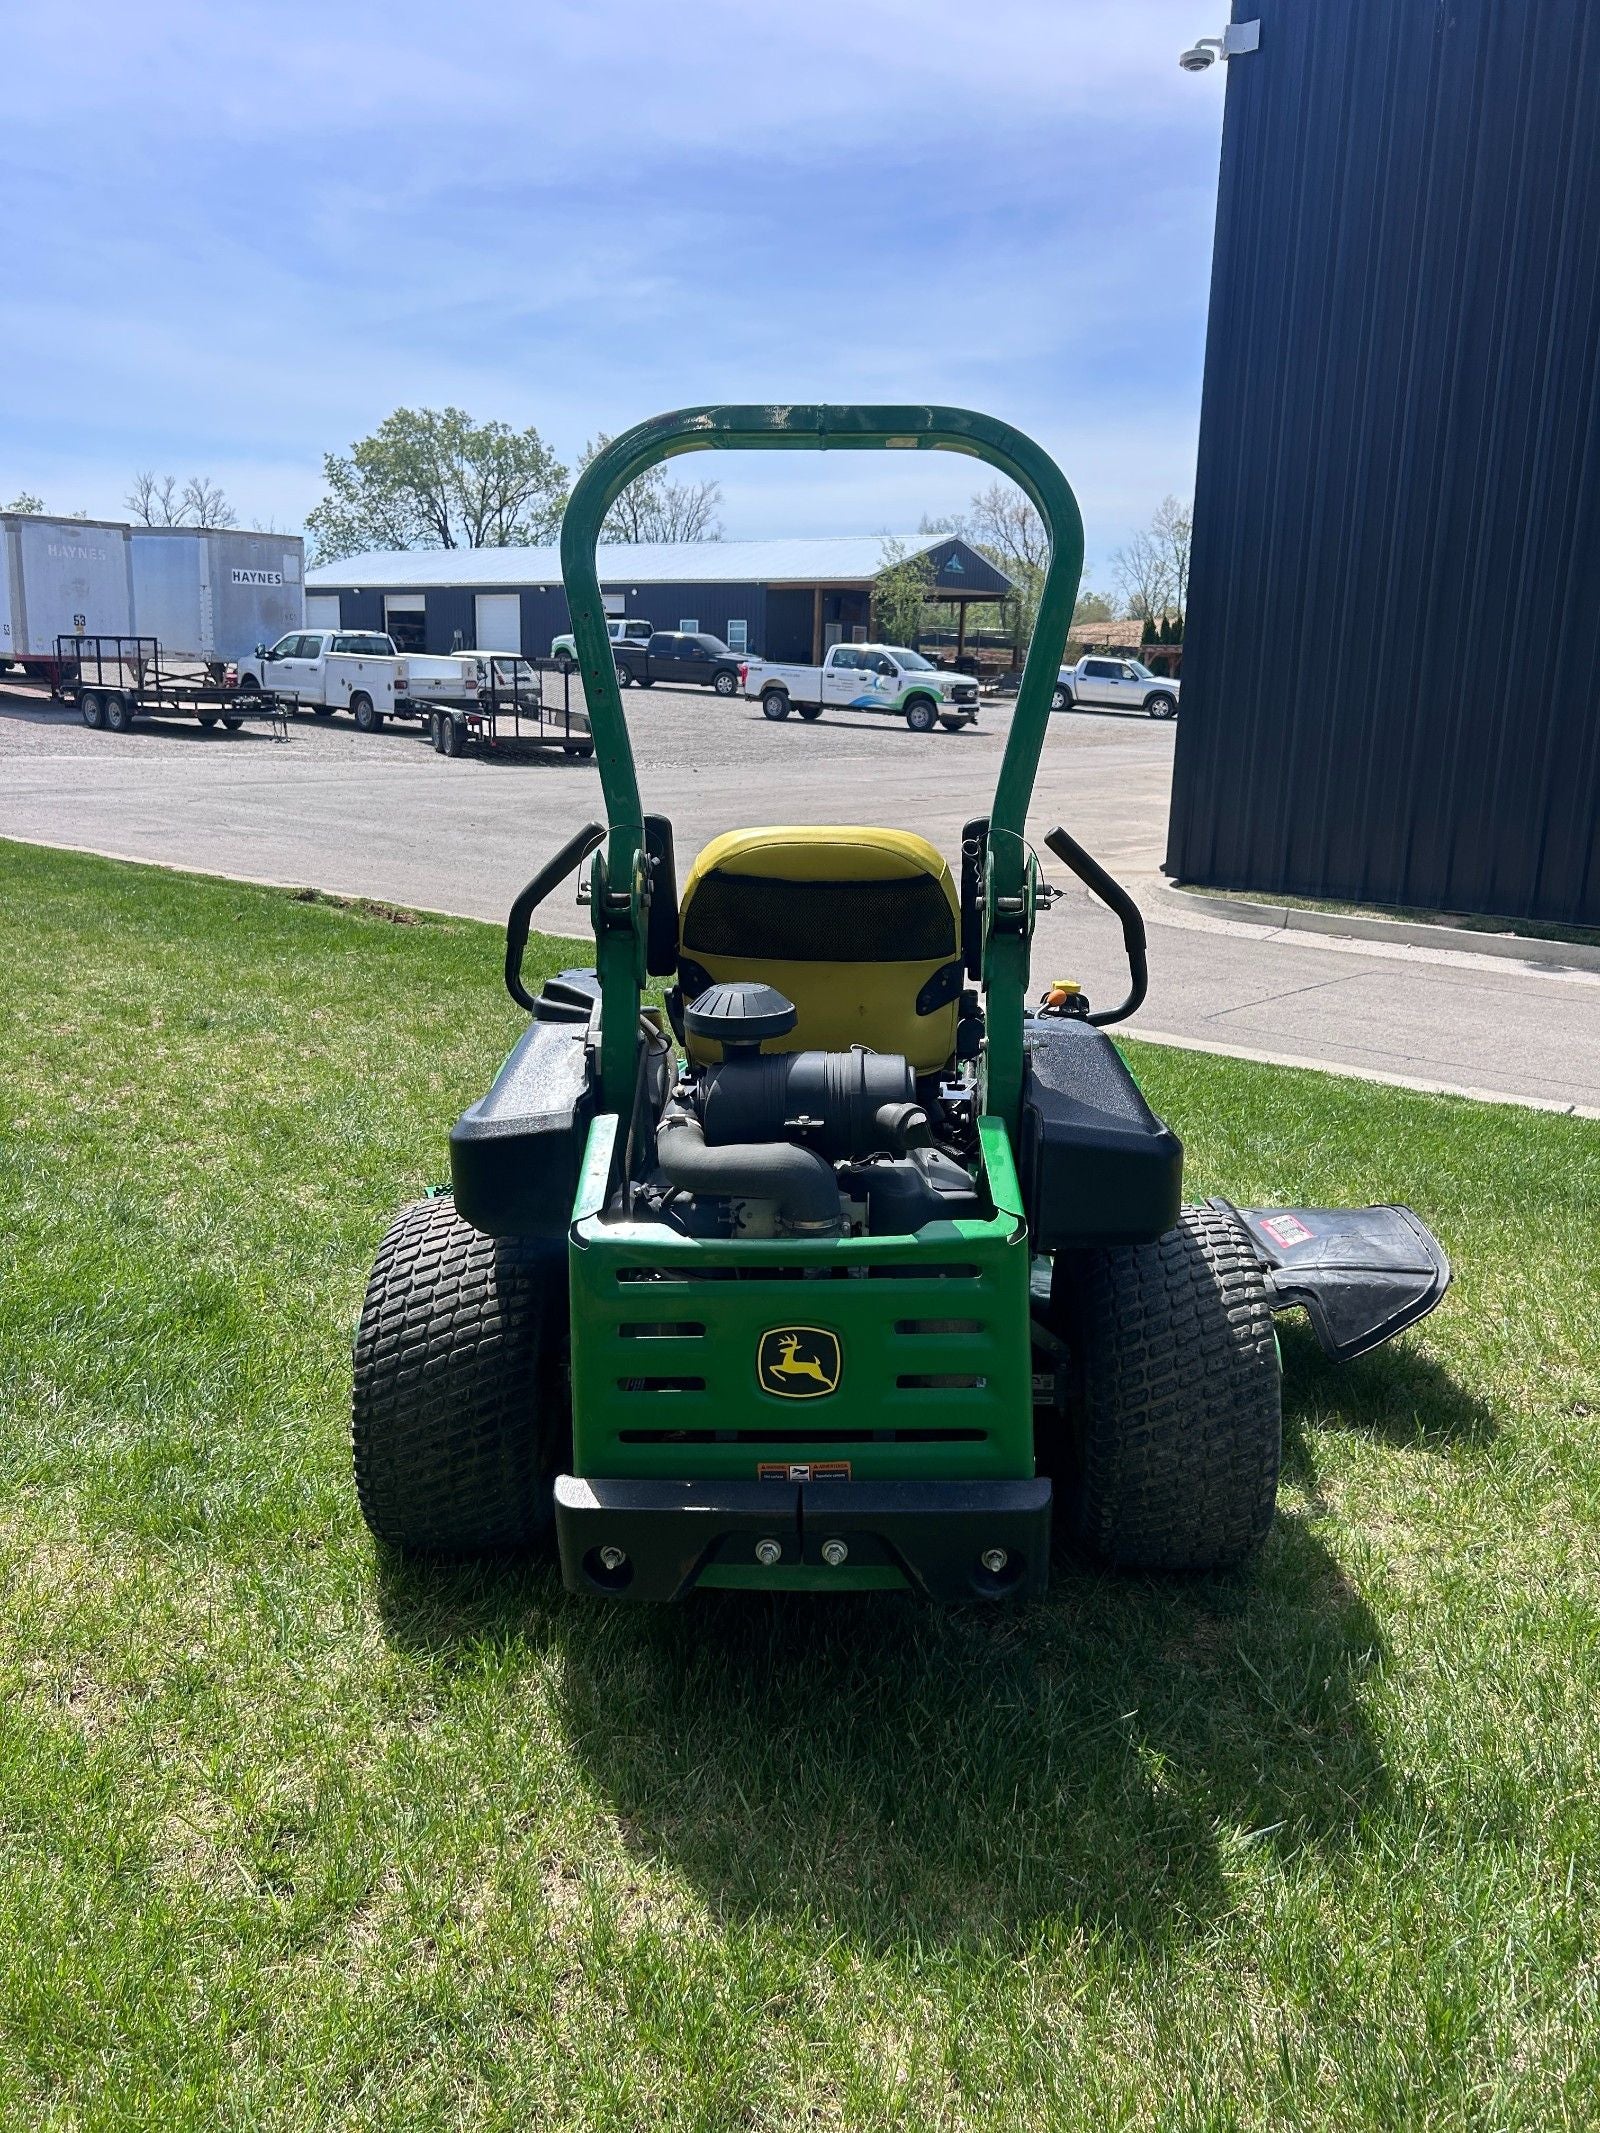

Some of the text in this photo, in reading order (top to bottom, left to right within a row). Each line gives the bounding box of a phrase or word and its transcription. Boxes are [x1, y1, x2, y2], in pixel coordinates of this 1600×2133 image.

[47, 544, 106, 560] HAYNES
[232, 571, 281, 584] HAYNES
[73, 614, 86, 626] 53
